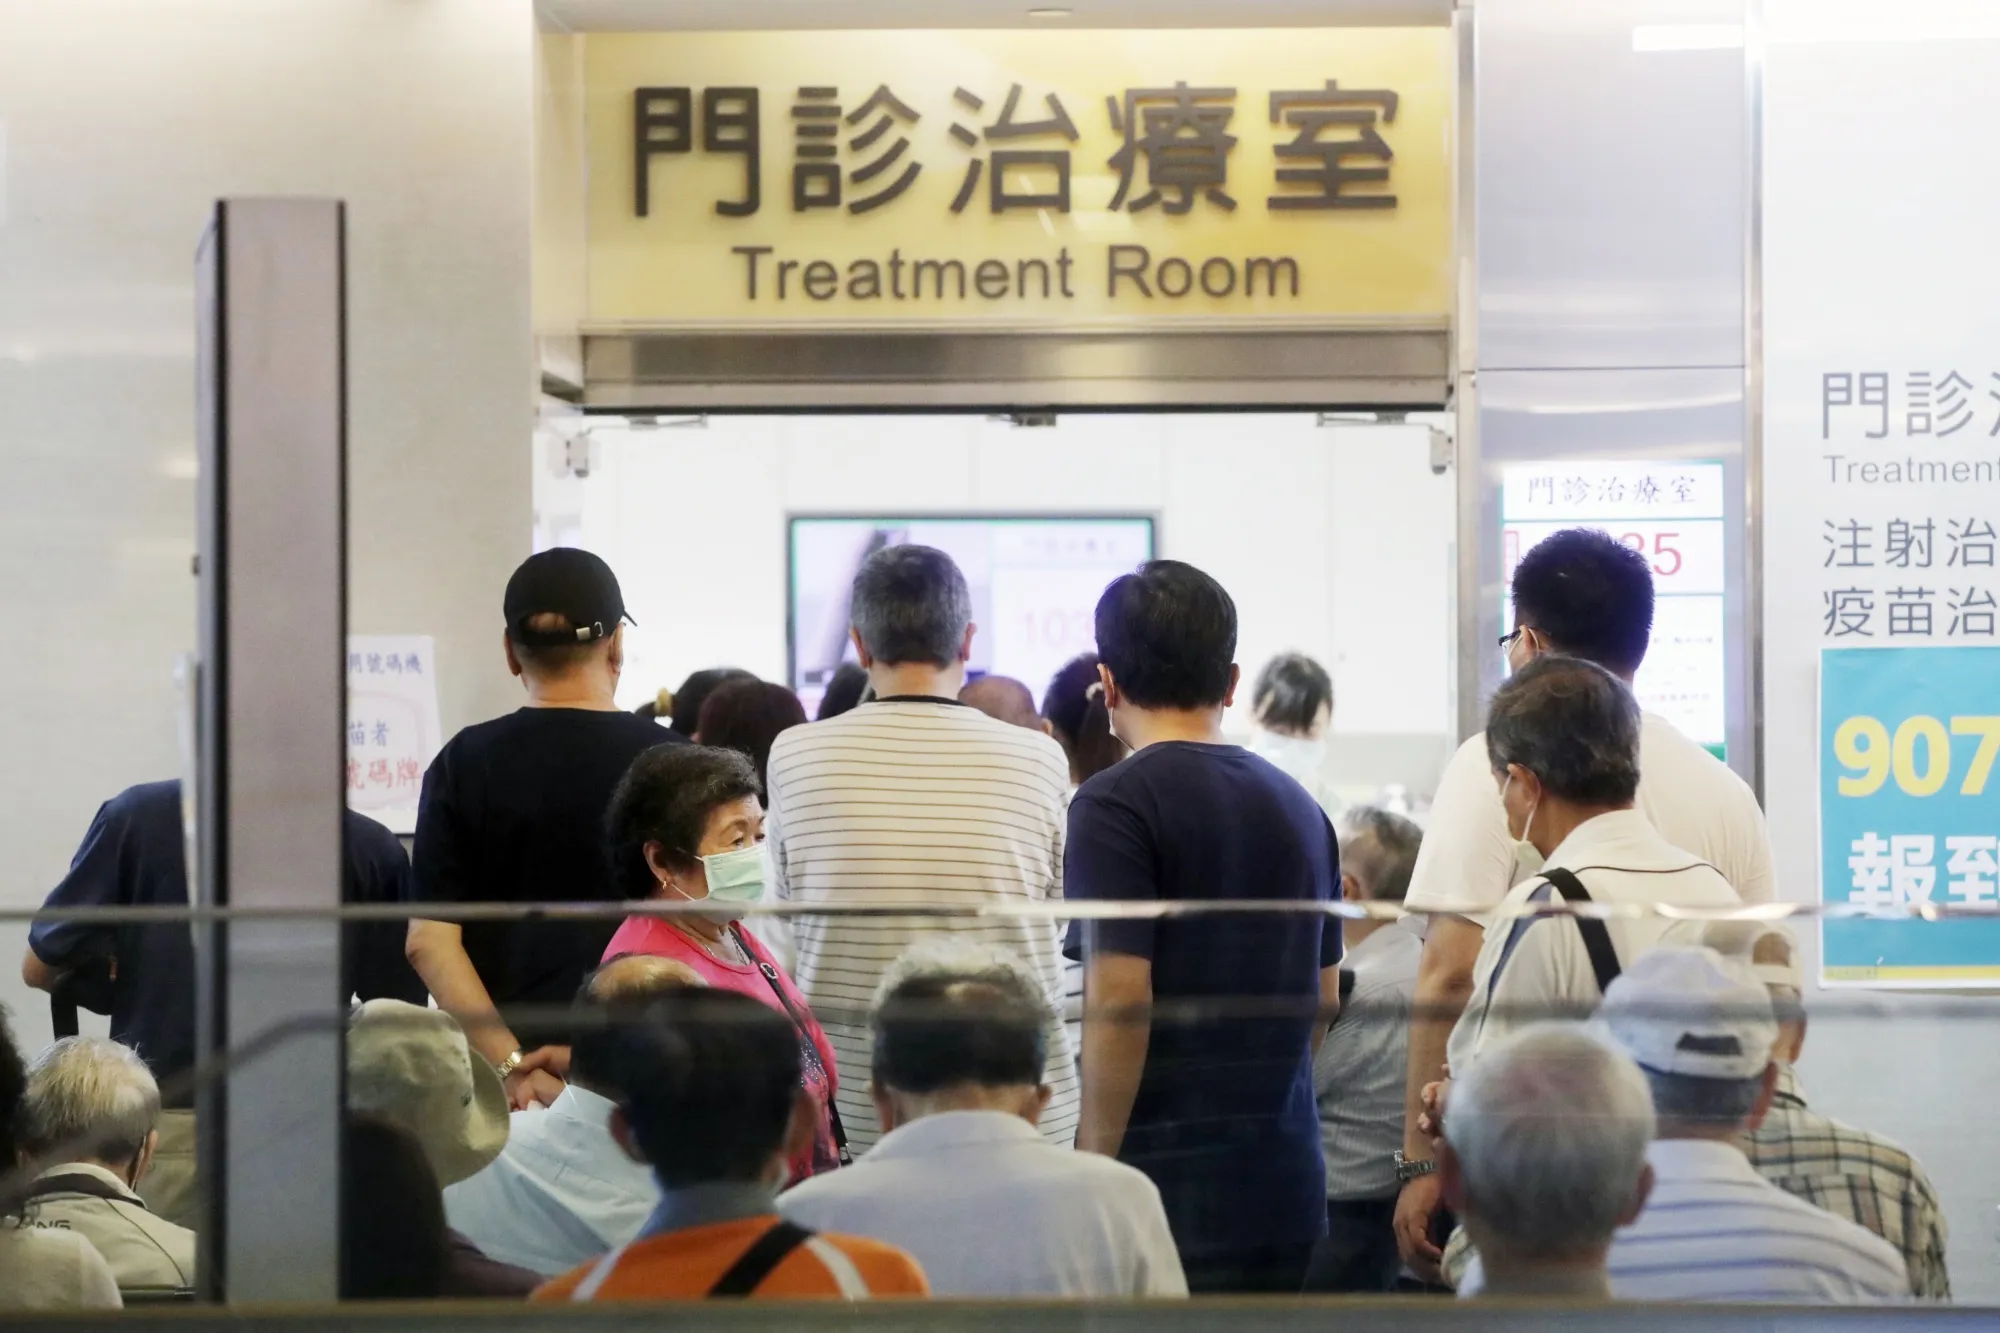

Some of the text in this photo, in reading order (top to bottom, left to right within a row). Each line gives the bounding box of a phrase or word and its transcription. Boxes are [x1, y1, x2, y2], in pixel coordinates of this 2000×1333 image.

[632, 80, 1400, 218] 門診治療室
[732, 245, 1300, 301] Treatment Room
[1823, 370, 2000, 440] 門診
[1528, 475, 1697, 506] 門診治療室
[1823, 517, 1998, 568] 注射治
[1823, 585, 1998, 638] 疫苗治
[1834, 714, 2000, 797] 907
